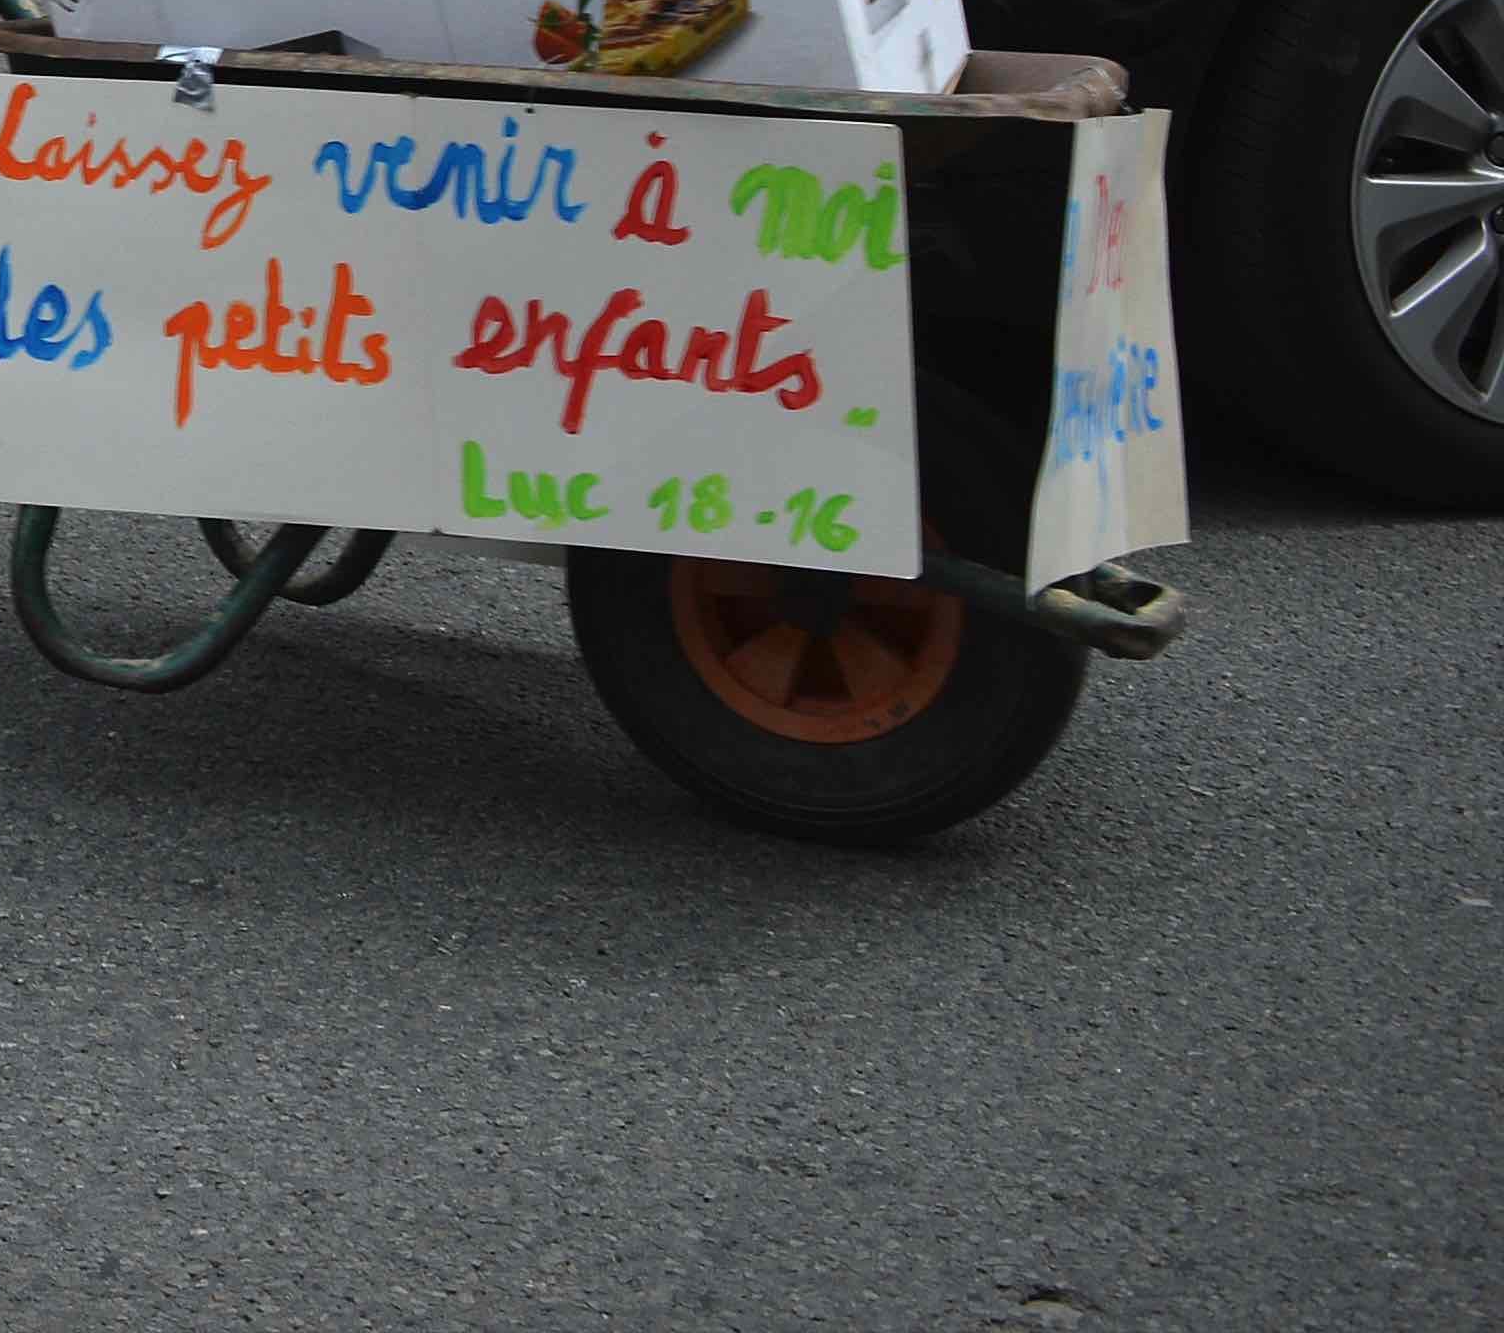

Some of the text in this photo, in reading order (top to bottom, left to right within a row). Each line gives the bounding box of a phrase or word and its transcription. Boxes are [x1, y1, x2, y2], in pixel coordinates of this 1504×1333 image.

[312, 106, 587, 229] venir
[610, 132, 693, 247] à
[730, 161, 906, 271] moi
[160, 257, 391, 428] petits
[458, 439, 611, 527] Luc
